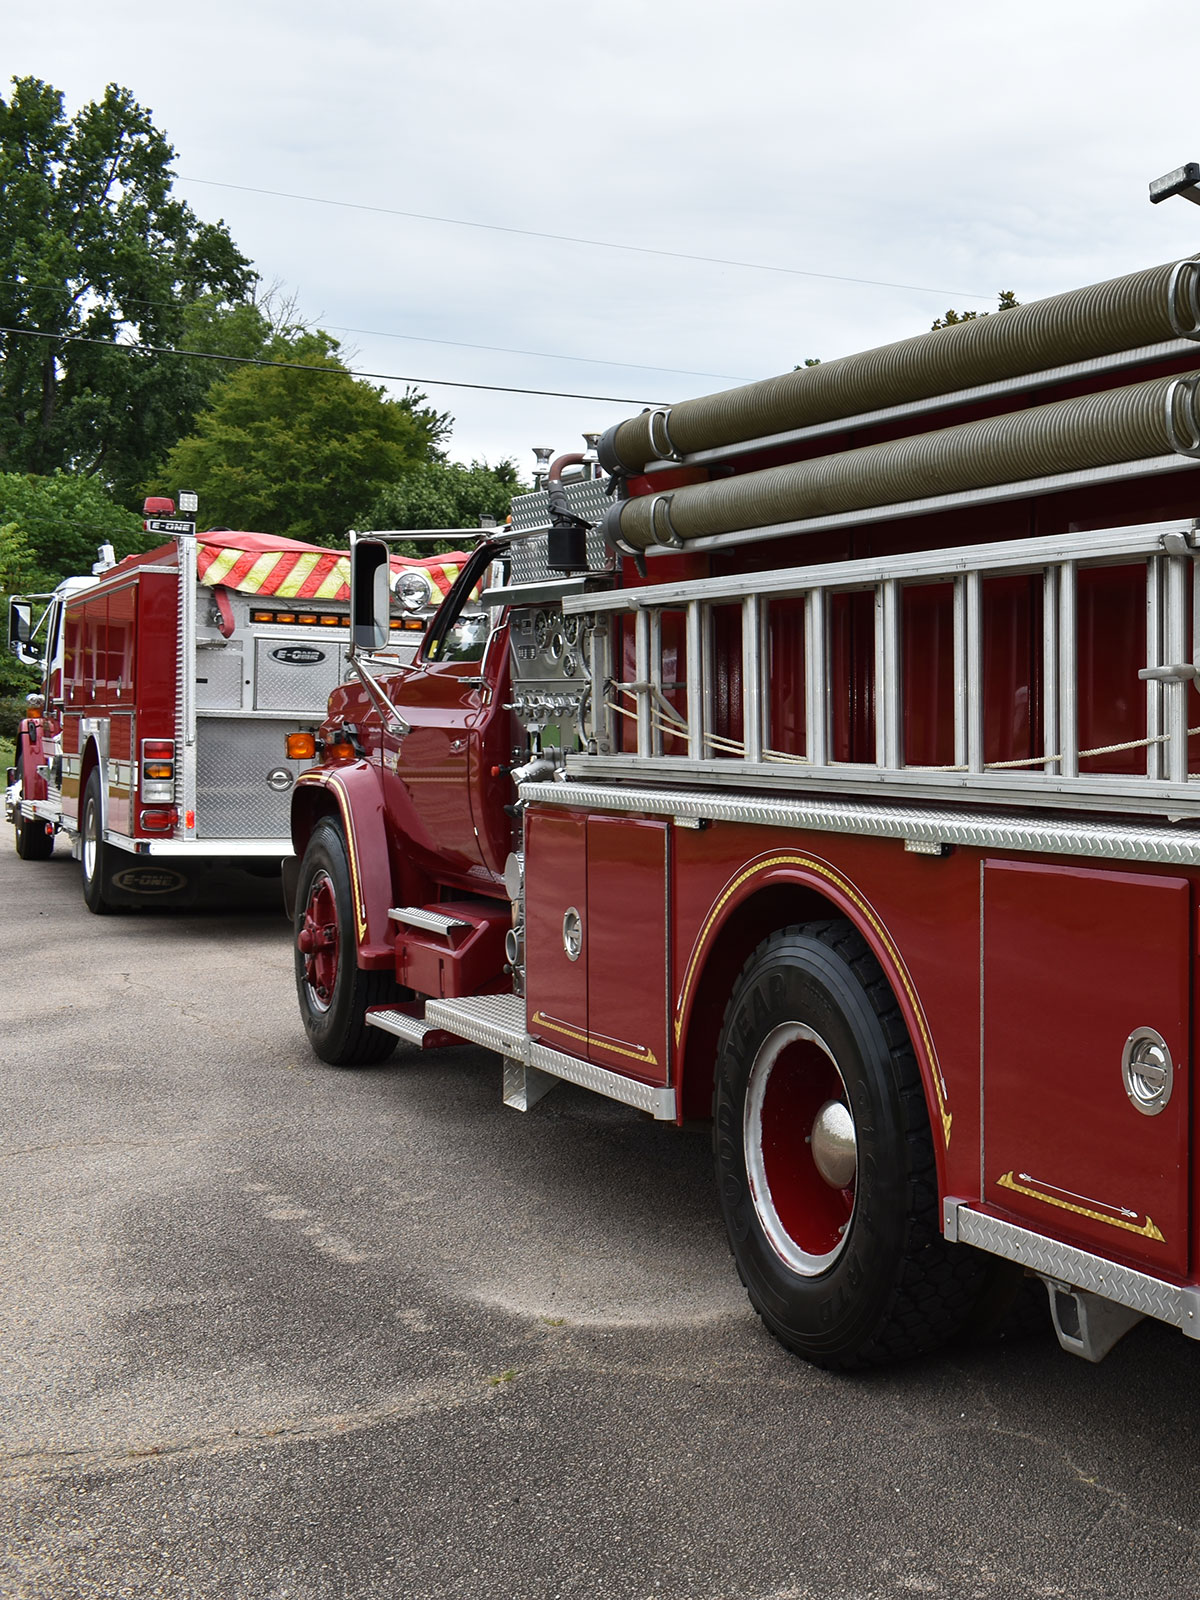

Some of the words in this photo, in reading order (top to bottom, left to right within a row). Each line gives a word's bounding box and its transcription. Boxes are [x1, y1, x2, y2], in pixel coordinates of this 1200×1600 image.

[152, 522, 190, 531] E-ONE
[276, 650, 320, 660] E-ONE
[122, 874, 174, 886] E-ONE
